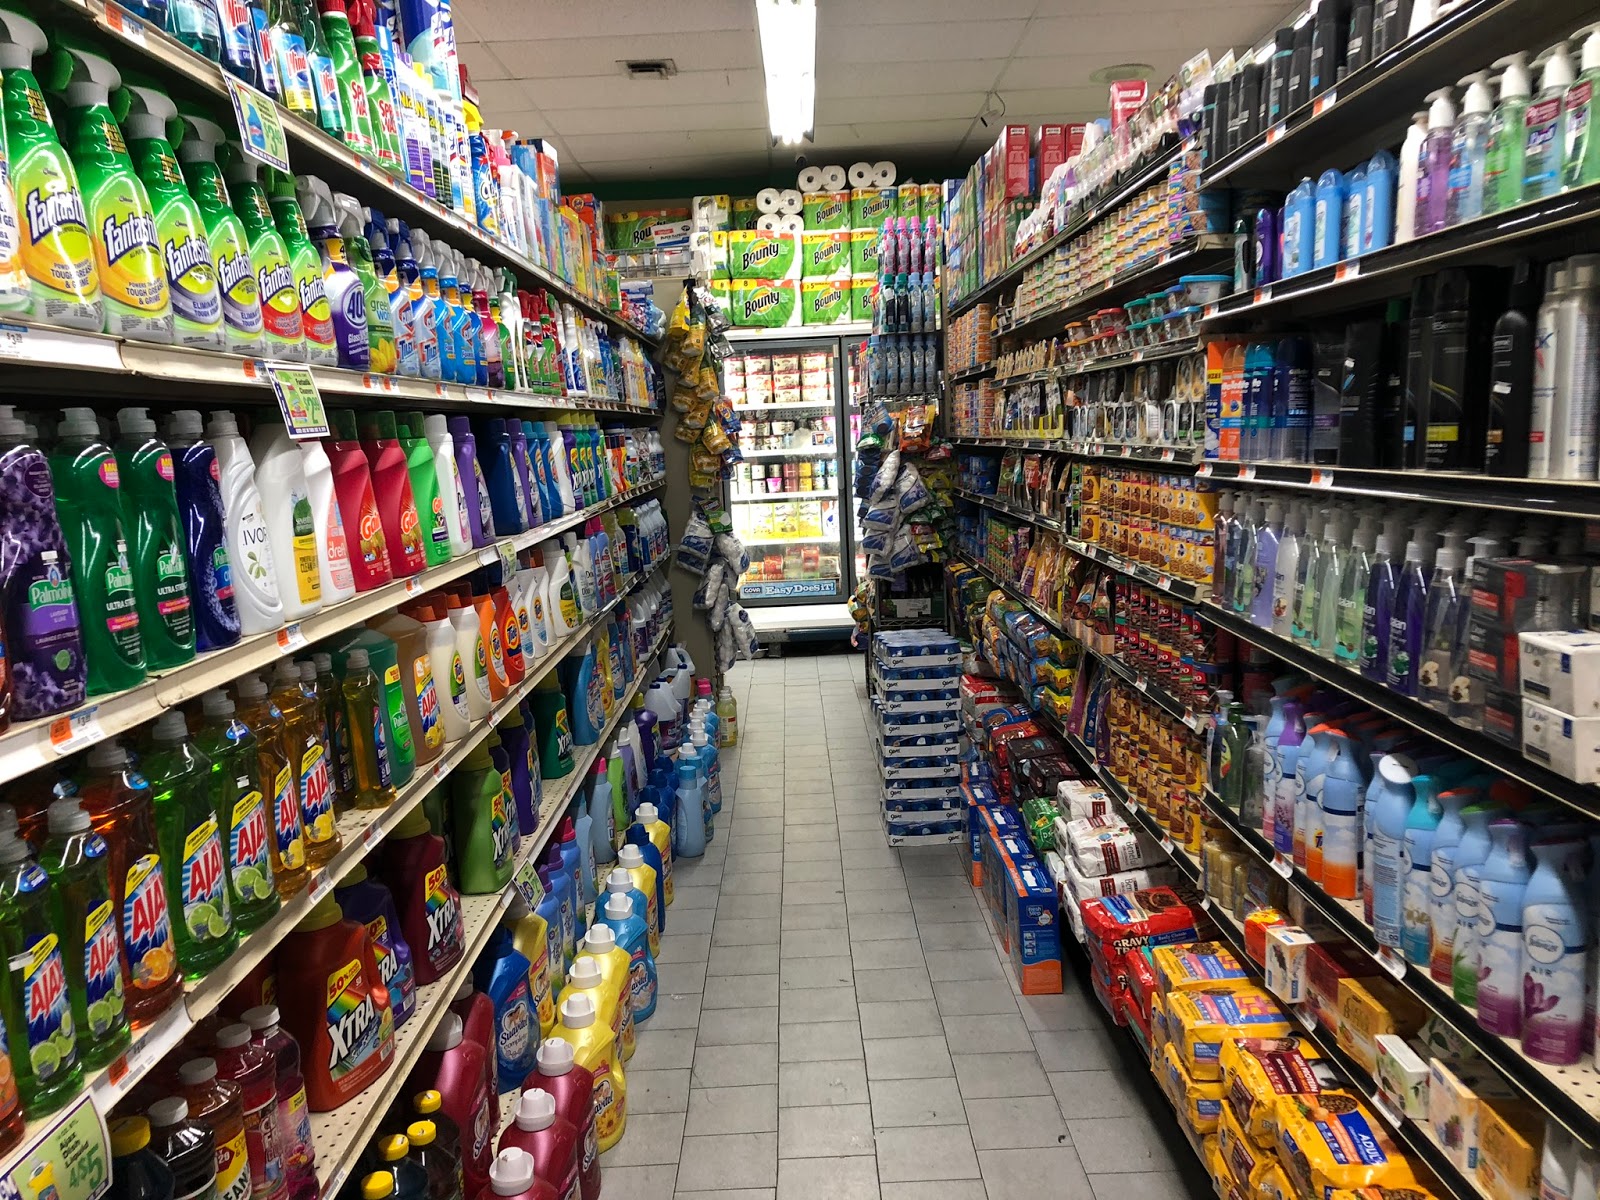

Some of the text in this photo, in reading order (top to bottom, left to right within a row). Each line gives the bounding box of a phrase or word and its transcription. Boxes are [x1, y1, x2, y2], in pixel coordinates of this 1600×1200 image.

[285, 50, 307, 76] Wind
[816, 202, 842, 225] Bounty
[862, 199, 890, 220] Bounty
[743, 242, 779, 271] Bounty
[814, 242, 841, 265] Bounty
[863, 245, 878, 262] Bou
[745, 291, 779, 319] Bounty
[815, 290, 841, 313] Bounty
[507, 624, 518, 645] Tide
[422, 687, 438, 716] AJA
[306, 764, 328, 808] AJA
[237, 811, 267, 865] AJA
[189, 840, 223, 902] AJA
[131, 875, 168, 945] AJA
[427, 897, 456, 950] XTRA
[88, 928, 118, 982] AJA
[1113, 936, 1149, 948] GRAVY
[1115, 946, 1138, 956] TRA
[379, 948, 399, 985] TRA
[1531, 966, 1552, 978] AIR
[328, 994, 375, 1069] XTRA
[1293, 1054, 1318, 1093] HIGH PROTEIN
[60, 1132, 76, 1151] Ajax
[62, 1140, 80, 1159] Dish
[65, 1141, 89, 1168] Liquid
